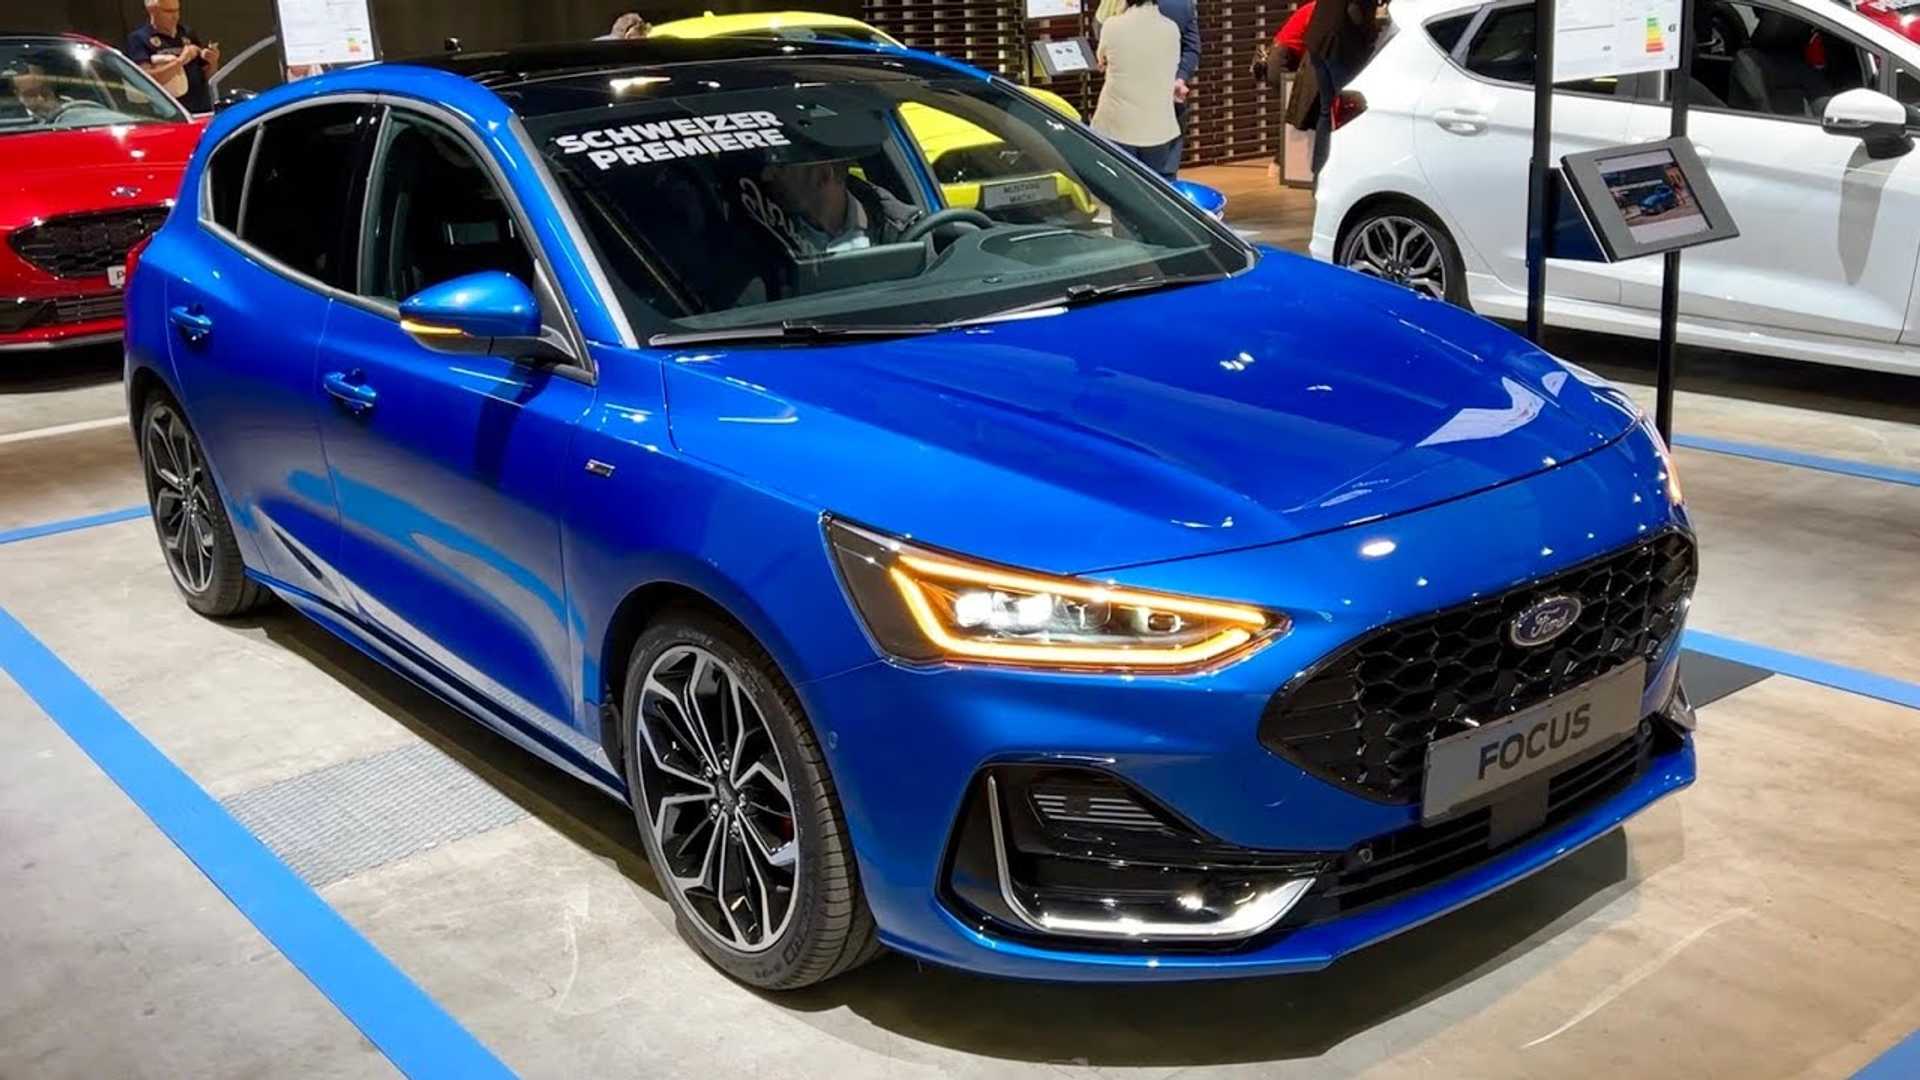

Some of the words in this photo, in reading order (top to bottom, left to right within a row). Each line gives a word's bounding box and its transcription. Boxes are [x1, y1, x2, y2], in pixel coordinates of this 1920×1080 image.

[556, 111, 784, 154] SCHWEIZER
[587, 129, 791, 170] PREMIERE
[1530, 606, 1569, 638] Ford
[1478, 703, 1591, 779] FOCUS
